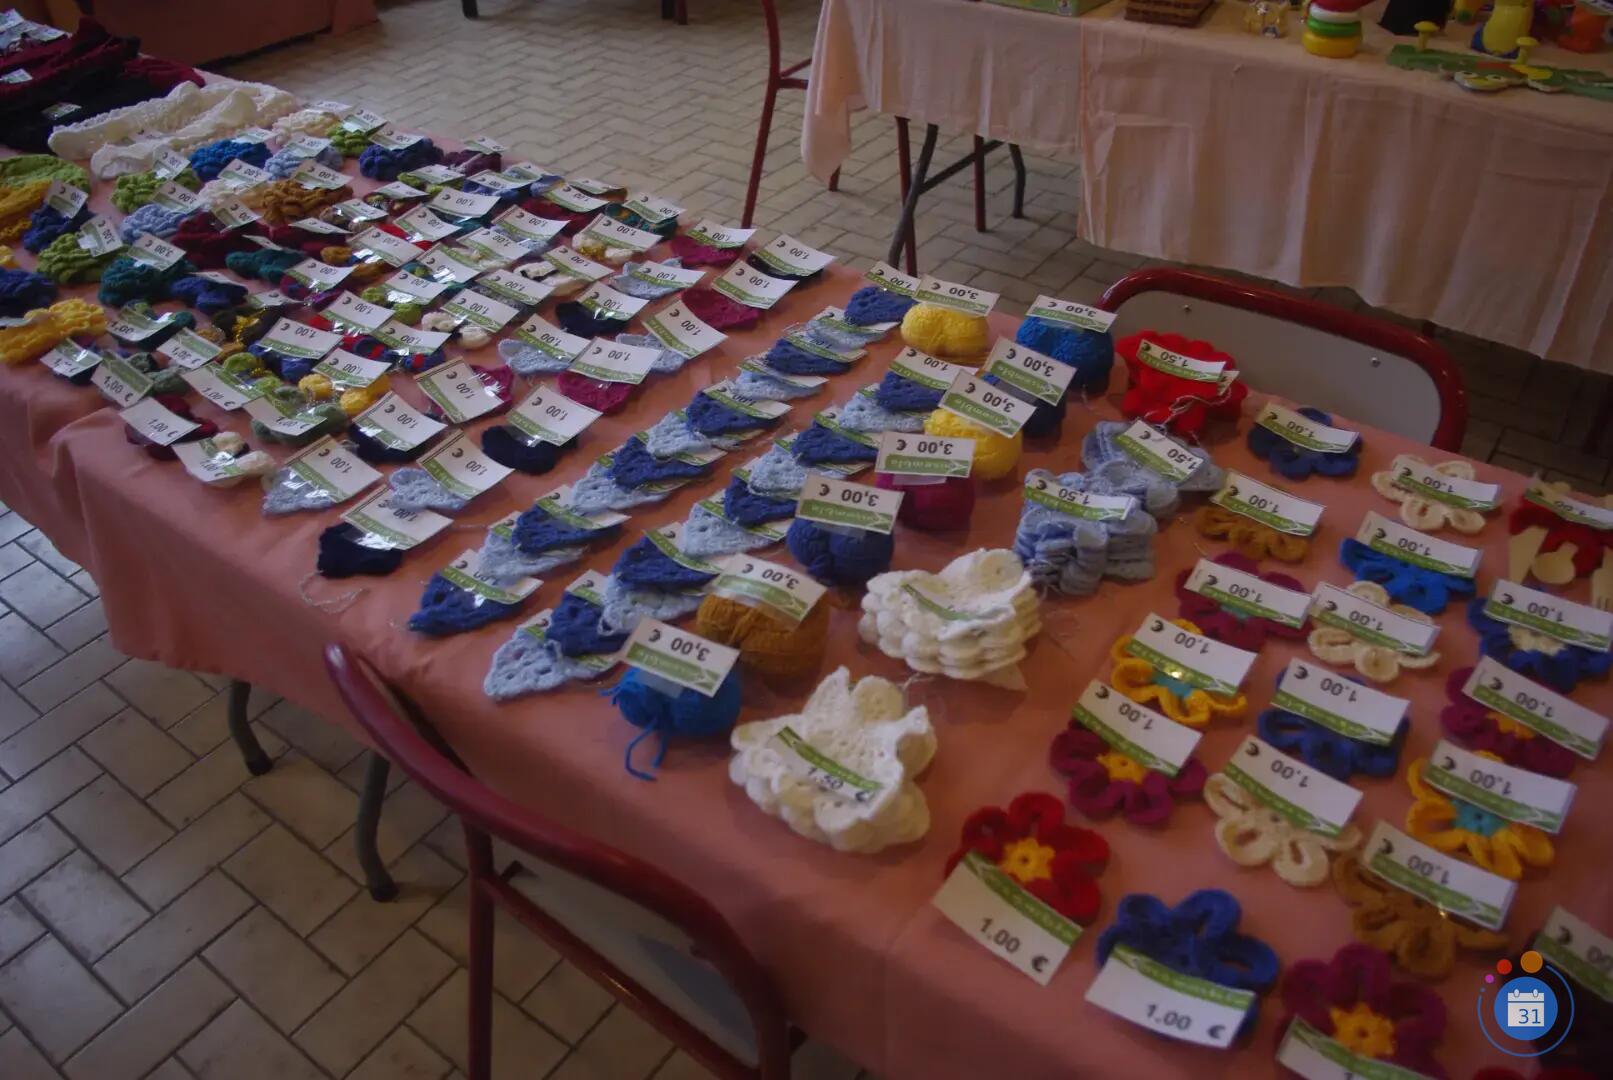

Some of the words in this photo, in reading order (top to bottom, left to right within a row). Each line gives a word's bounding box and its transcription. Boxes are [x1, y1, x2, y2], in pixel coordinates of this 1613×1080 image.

[441, 193, 451, 201] €
[602, 219, 613, 227] €
[776, 240, 787, 249] €
[736, 268, 745, 276] €
[931, 282, 942, 290] €
[590, 291, 600, 299] €
[949, 287, 980, 301] 3,00
[341, 296, 352, 305] €
[456, 297, 466, 305] €
[669, 307, 680, 318] €
[1066, 304, 1097, 318] 3,00
[280, 322, 291, 331] €
[385, 327, 396, 335] €
[526, 324, 537, 333] €
[592, 346, 603, 355] €
[906, 349, 918, 357] €
[1006, 348, 1017, 360] €
[328, 357, 340, 366] €
[1023, 356, 1055, 377] 3,00
[446, 371, 458, 380] €
[964, 382, 977, 394] €
[124, 392, 135, 402] €
[531, 396, 543, 406] €
[983, 391, 1016, 413] 3,00
[384, 404, 396, 414] €
[1269, 411, 1278, 421] €
[1140, 430, 1152, 440] €
[1286, 421, 1315, 438] 1.00
[896, 439, 907, 451] €
[917, 441, 954, 455] 3,00
[318, 448, 330, 457] €
[452, 447, 464, 458] €
[1402, 467, 1413, 477] €
[819, 484, 831, 497] €
[1036, 479, 1048, 491] €
[1422, 476, 1455, 493] 1.00
[841, 488, 880, 507] 3,00
[1228, 486, 1240, 497] €
[1248, 494, 1280, 514] 1.00
[1375, 528, 1387, 539] €
[1398, 536, 1431, 556] 1.00
[742, 563, 755, 575] €
[762, 568, 800, 590] 3,00
[1207, 575, 1218, 586] €
[1229, 583, 1263, 603] 1.00
[1501, 593, 1514, 605] €
[1326, 600, 1338, 612] €
[1527, 602, 1564, 623] 1.00
[1150, 620, 1164, 633] €
[1349, 610, 1384, 632] 1.00
[649, 629, 662, 643] €
[1174, 632, 1209, 654] 1.00
[671, 638, 711, 662] 3,00
[1294, 666, 1308, 679] €
[1490, 677, 1503, 690] €
[1096, 686, 1110, 699] €
[1319, 678, 1357, 703] 1.00
[1515, 691, 1553, 718] 1.00
[1120, 703, 1154, 731] 1.00
[1246, 742, 1259, 756] €
[1442, 756, 1456, 771] €
[1270, 760, 1309, 788] 1.00
[1470, 769, 1512, 796] 1.00
[1379, 838, 1394, 854] €
[1407, 855, 1450, 885] 1.00
[980, 917, 1021, 952] 1.00
[1032, 955, 1051, 973] €
[1145, 1003, 1191, 1031] 1.00
[1208, 1024, 1226, 1039] €
